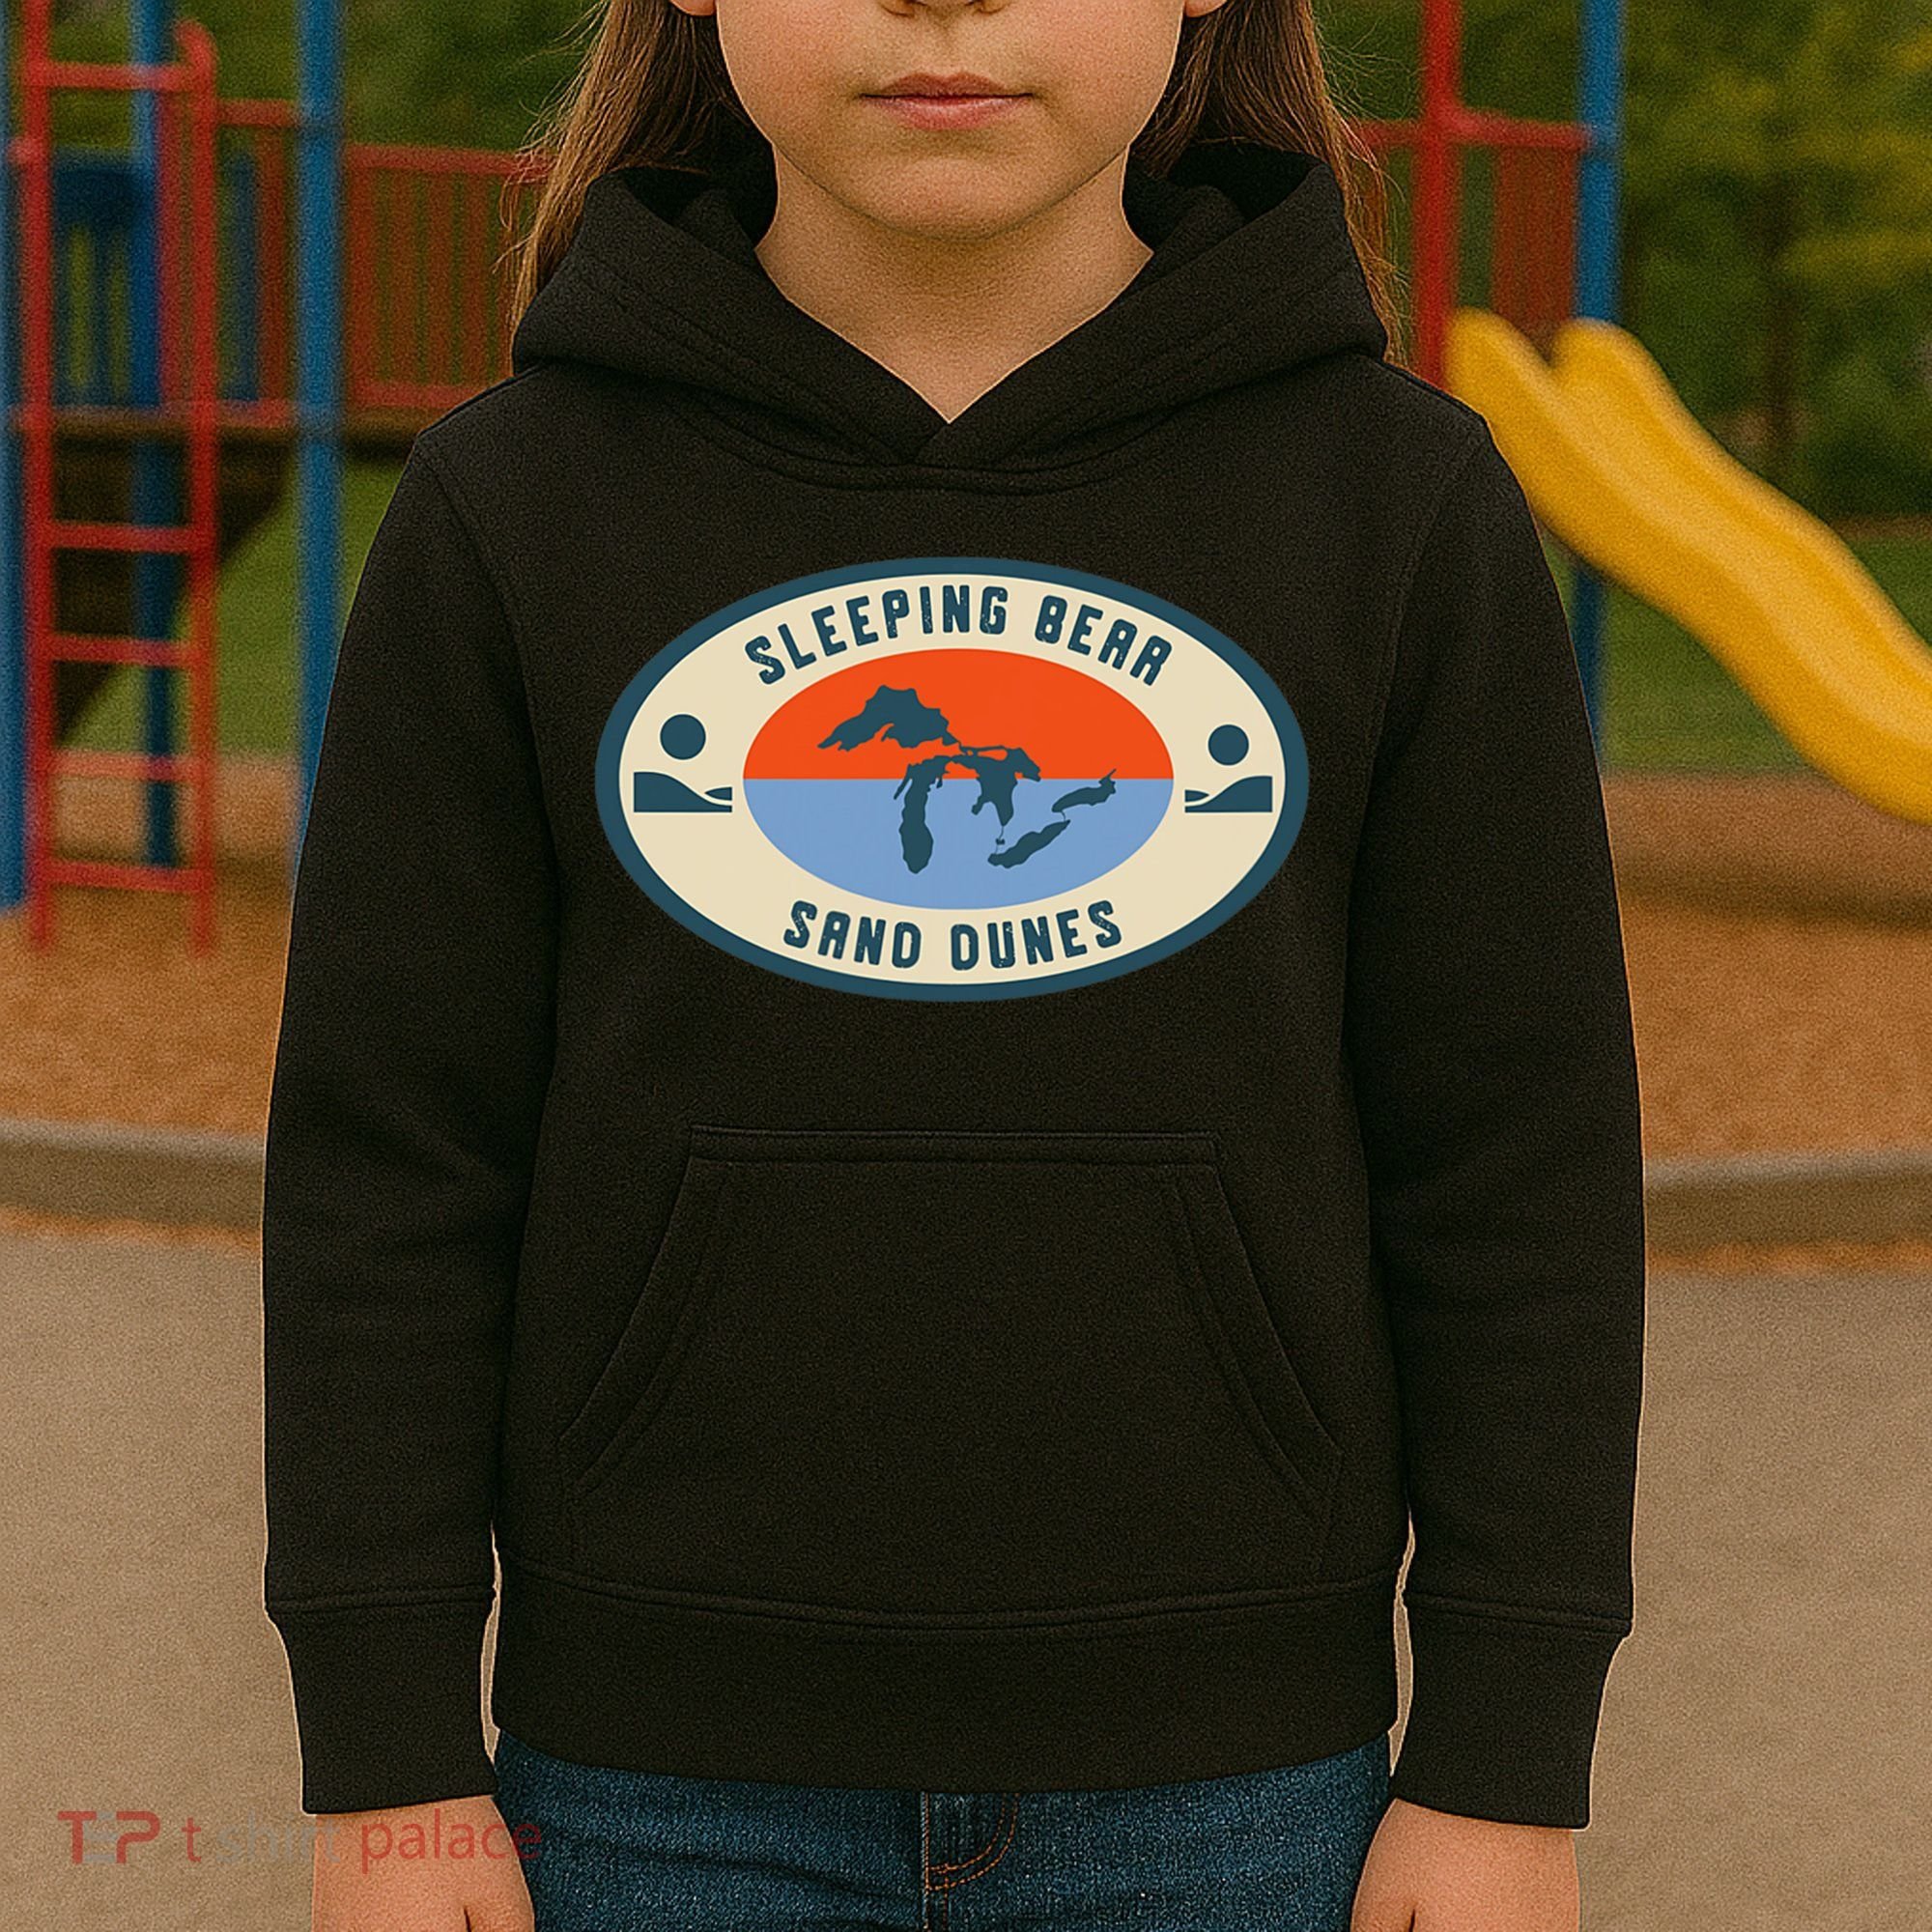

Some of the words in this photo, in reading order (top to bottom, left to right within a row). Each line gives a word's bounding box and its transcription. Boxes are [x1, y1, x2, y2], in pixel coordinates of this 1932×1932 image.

[744, 584, 1009, 685] SLEEPING
[1034, 594, 1173, 687] BEAR
[782, 900, 922, 969] SAND
[950, 899, 1122, 971] DUNES
